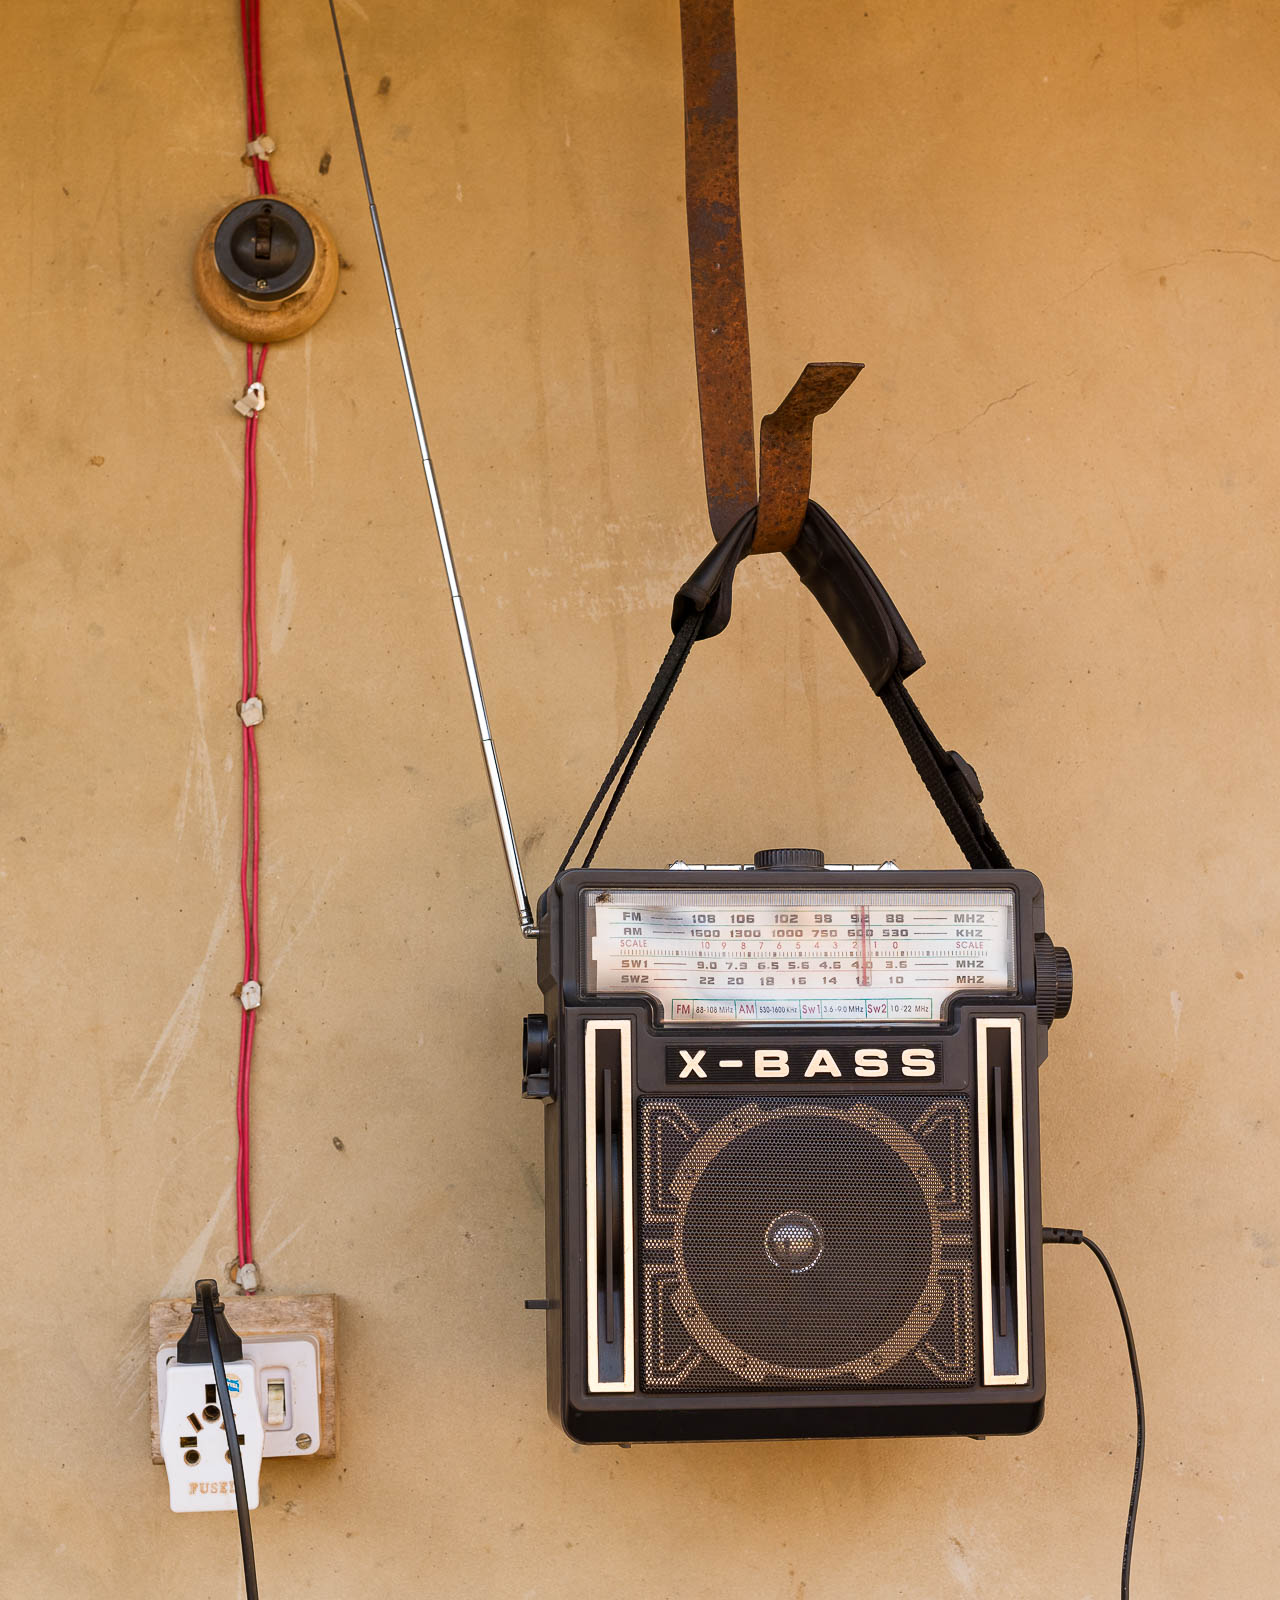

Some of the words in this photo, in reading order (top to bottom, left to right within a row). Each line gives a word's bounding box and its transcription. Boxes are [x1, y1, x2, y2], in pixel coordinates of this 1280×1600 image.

[622, 911, 642, 922] FM
[691, 914, 716, 924] 108
[730, 914, 755, 924] 106
[774, 914, 799, 924] 102
[814, 914, 833, 924] 98
[850, 914, 870, 924] 92
[885, 914, 905, 924] 88
[953, 914, 985, 924] MHZ
[623, 927, 642, 936] AM
[690, 929, 720, 938] 1600
[730, 929, 761, 938] 1300
[772, 929, 804, 938] 1000
[811, 929, 838, 938] 750
[847, 929, 874, 938] 600
[882, 929, 909, 938] 530
[955, 929, 983, 938] KHZ
[620, 939, 648, 948] SCALE
[701, 941, 710, 949] 10
[721, 941, 727, 949] 9
[741, 941, 747, 949] 8
[759, 941, 764, 949] 7
[777, 941, 782, 949] 6
[795, 941, 801, 949] 5
[814, 941, 820, 949] 4
[832, 941, 838, 949] 3
[852, 941, 858, 949] 2
[892, 941, 898, 949] 0
[955, 941, 985, 949] SCALE
[621, 959, 648, 968] SW1
[696, 961, 718, 970] 9.0
[956, 960, 985, 968] MHZ
[620, 975, 649, 984] SW2
[699, 976, 715, 985] 22
[727, 976, 744, 985] 20
[759, 977, 775, 986] 18
[822, 976, 838, 985] 14
[889, 976, 904, 985] 10
[956, 976, 985, 984] MHZ
[676, 1004, 691, 1014] FM
[738, 1004, 755, 1014] AM
[848, 1005, 864, 1013] MHz
[914, 1005, 929, 1013] MHz
[678, 1048, 936, 1078] X-BASS
